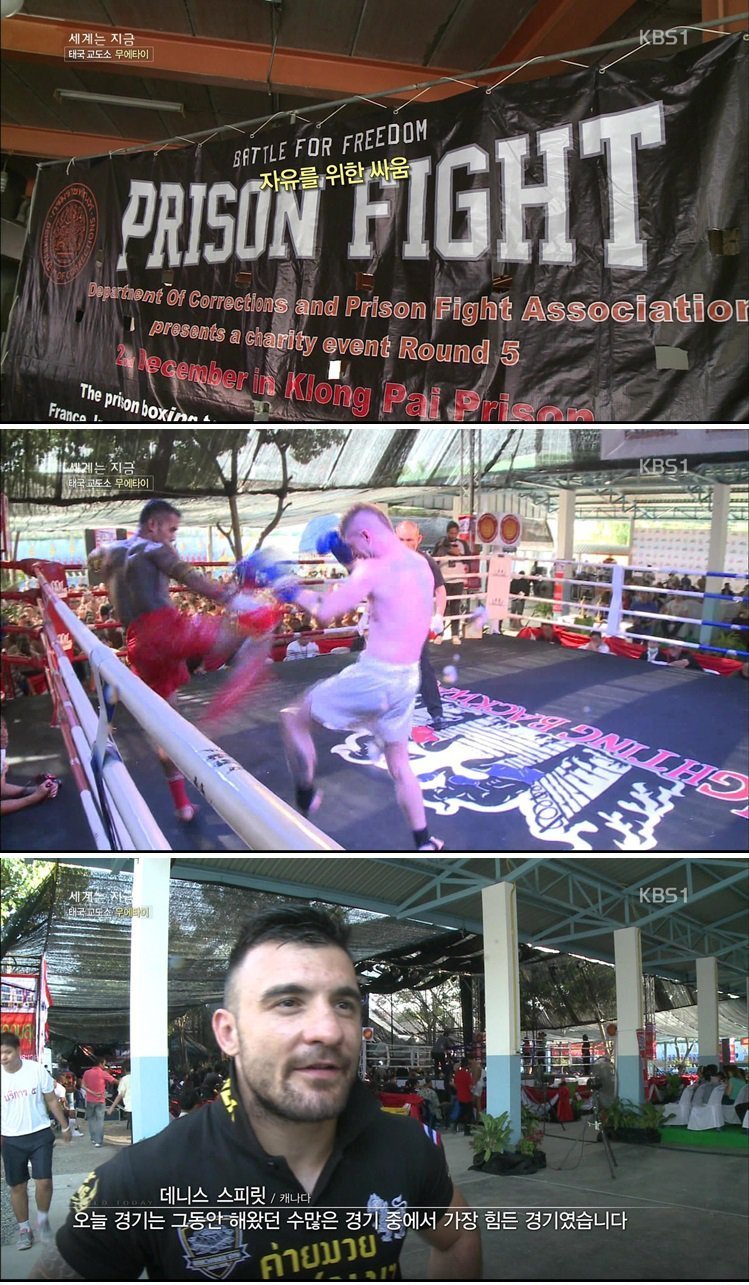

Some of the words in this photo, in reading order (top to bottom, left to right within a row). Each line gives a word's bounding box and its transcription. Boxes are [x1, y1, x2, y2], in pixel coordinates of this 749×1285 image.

[233, 140, 286, 167] BATTLE
[295, 137, 332, 158] FOR
[342, 119, 427, 156] FREEDOM
[117, 179, 326, 272] PRISON
[348, 100, 666, 271] FIGHT
[88, 282, 163, 305] Department
[166, 289, 186, 306] Of
[189, 292, 289, 313] Corrections
[294, 295, 339, 319] and
[345, 296, 426, 320] Prison
[435, 295, 513, 327] Fight
[149, 319, 226, 344] presents
[230, 330, 241, 345] a
[245, 328, 317, 357] charity
[322, 335, 391, 359] event
[399, 337, 490, 365] Round
[500, 340, 520, 366] 5
[80, 382, 102, 402] The
[104, 392, 140, 414] prison
[253, 368, 275, 396] in
[284, 372, 372, 418] Klong
[382, 383, 440, 419] Pai
[454, 388, 596, 422] Prison
[260, 1234, 377, 1280] ค่ายมวย
